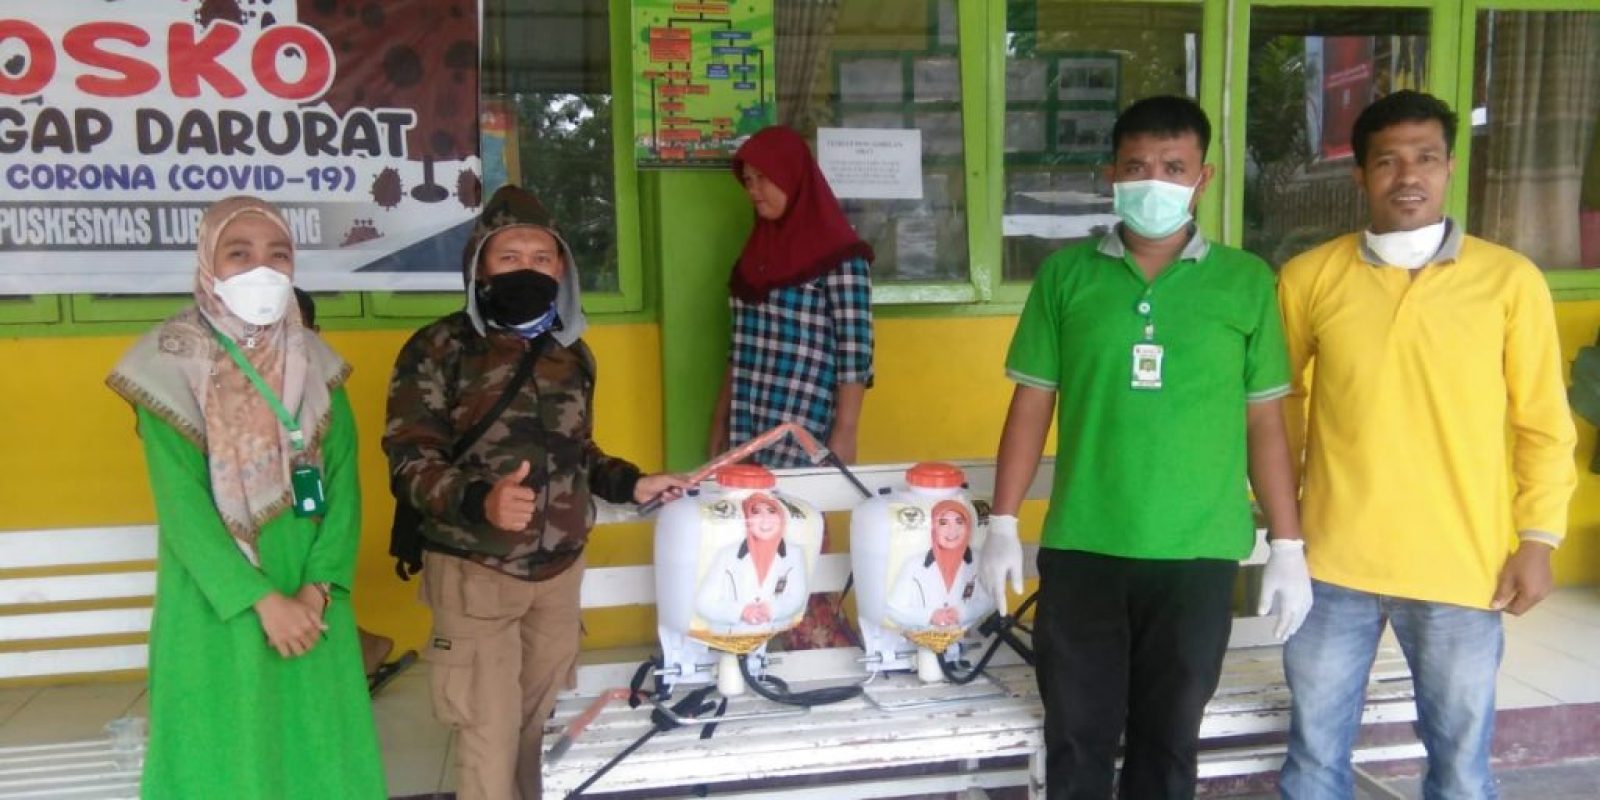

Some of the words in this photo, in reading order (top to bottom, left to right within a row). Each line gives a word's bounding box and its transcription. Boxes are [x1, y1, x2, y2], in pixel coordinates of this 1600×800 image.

[136, 108, 413, 157] DARURAT
[6, 163, 156, 191] CORONA
[168, 164, 356, 192] (COVID-19)
[0, 207, 152, 245] PUSKESMAS
